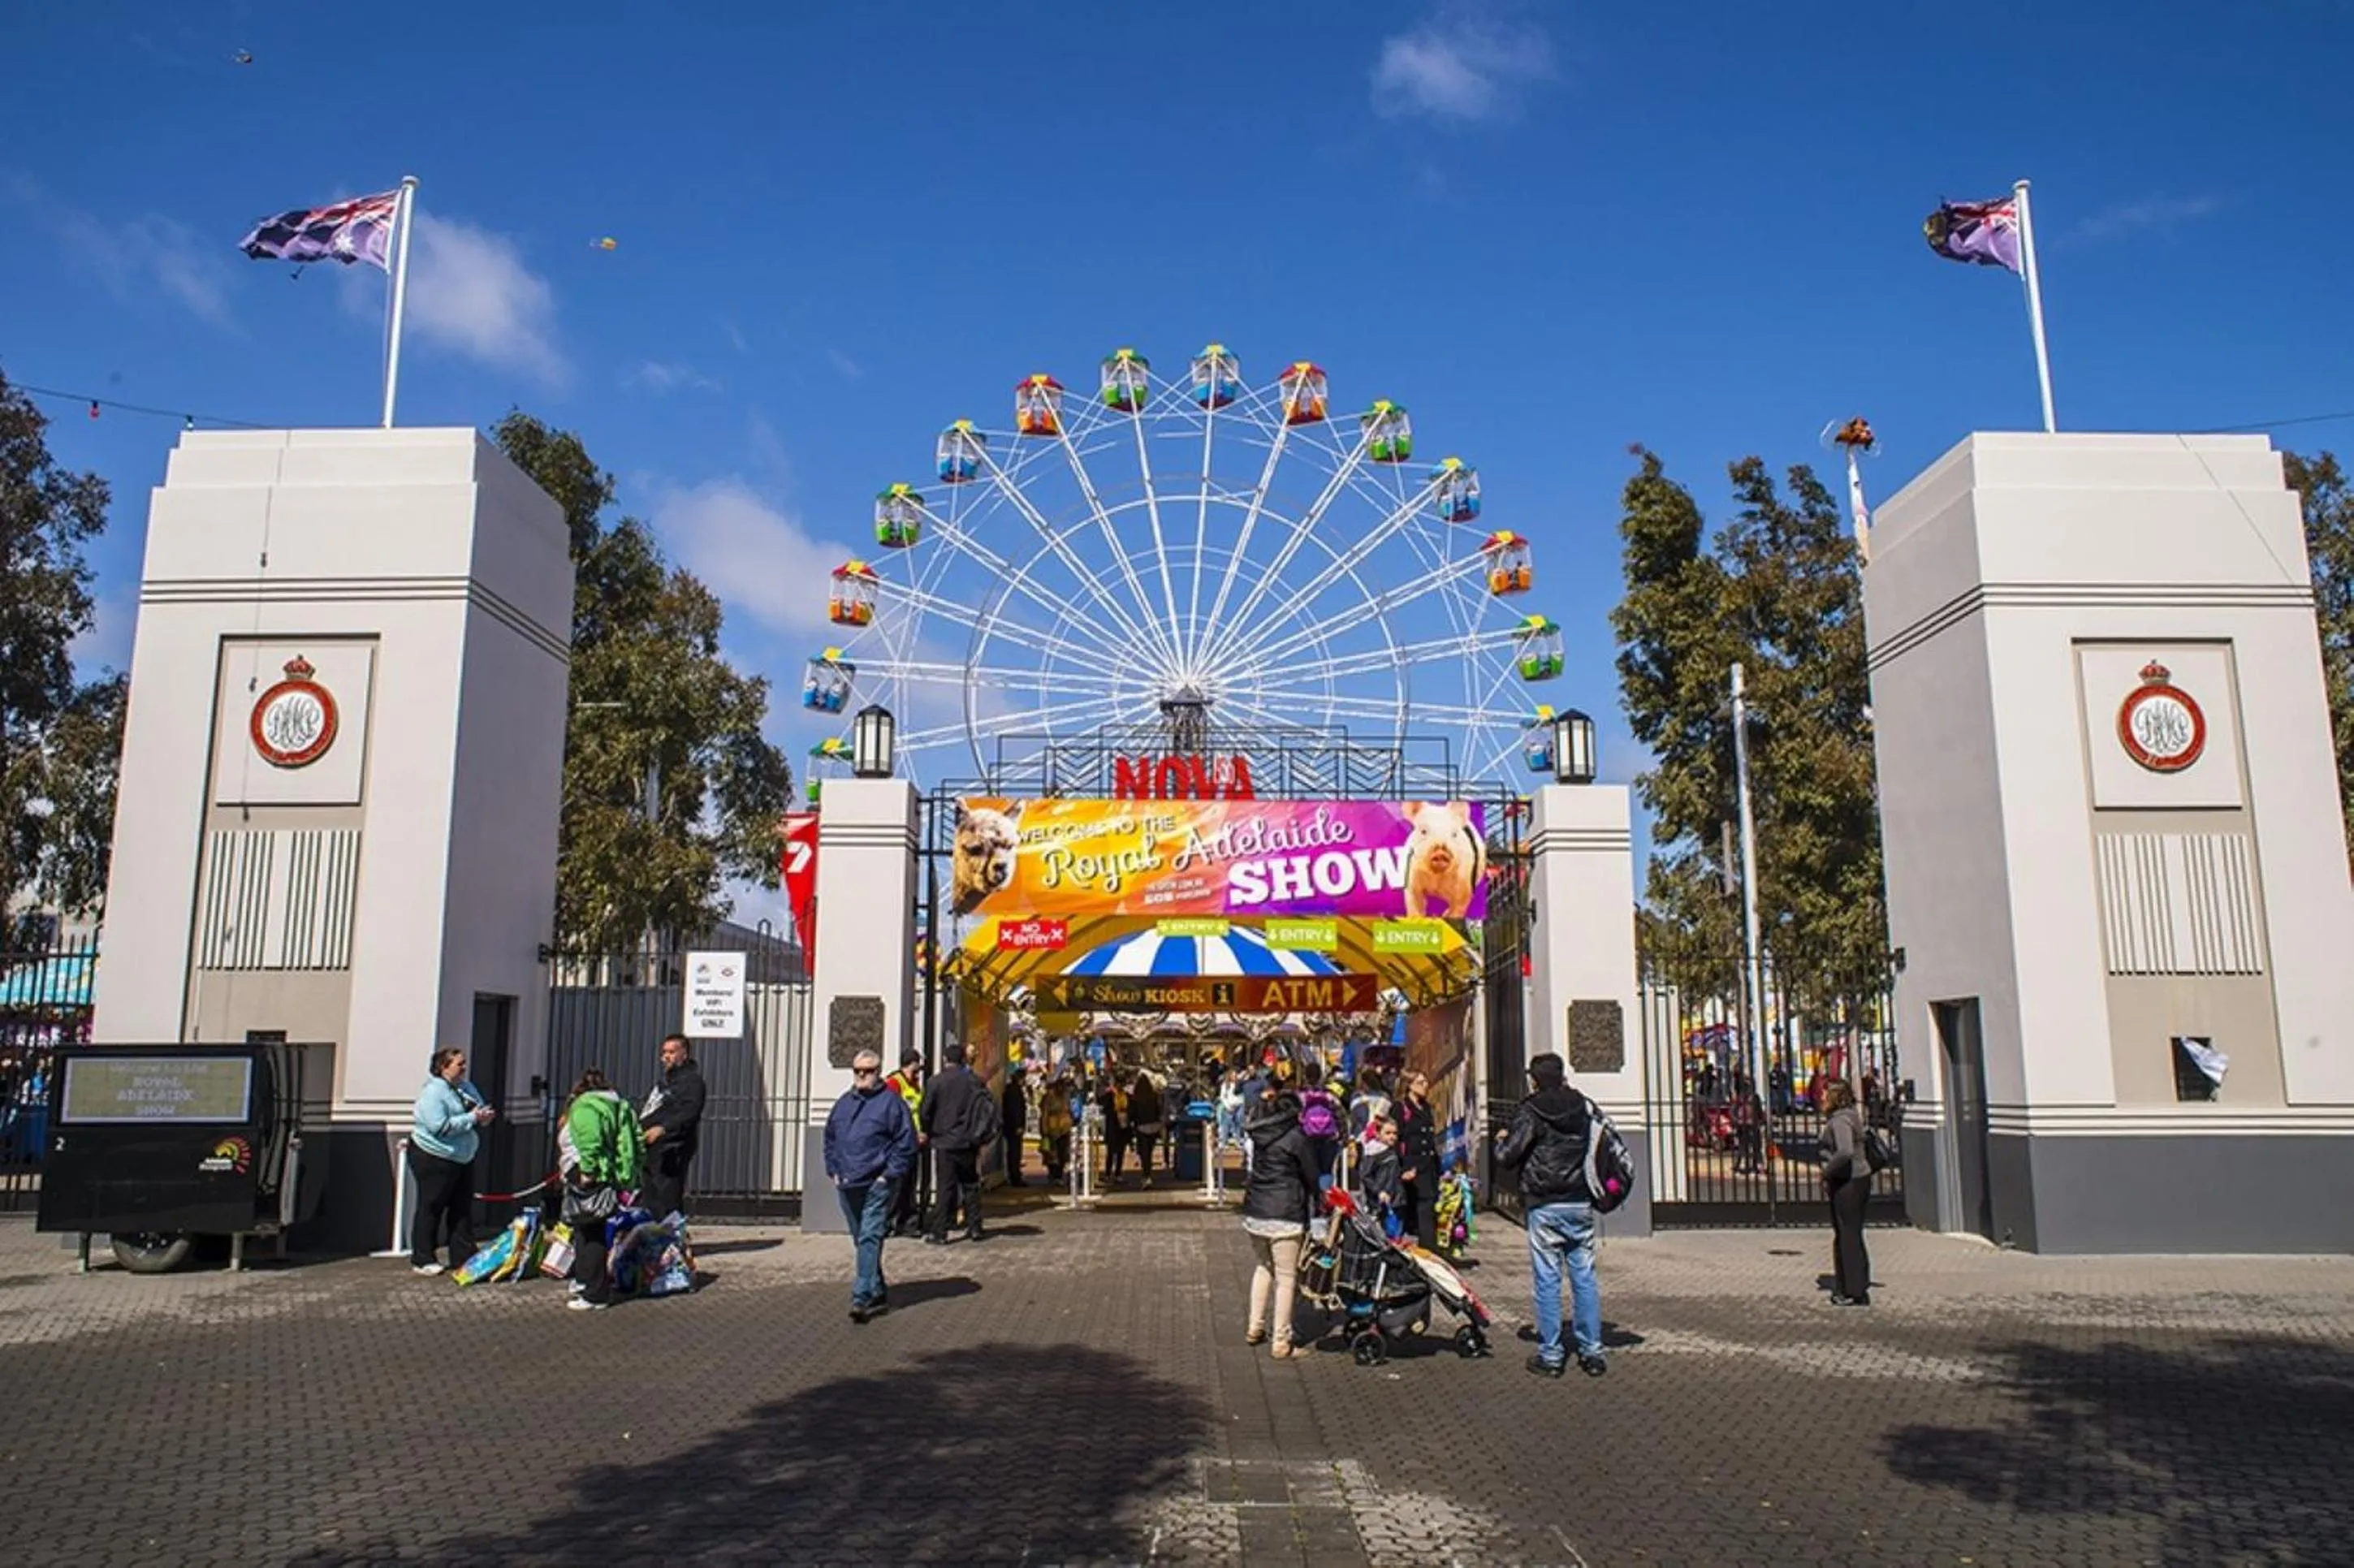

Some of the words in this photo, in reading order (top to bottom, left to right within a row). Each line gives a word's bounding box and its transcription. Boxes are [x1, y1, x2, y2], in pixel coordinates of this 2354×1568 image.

[1116, 754, 1255, 800] NOVA
[1017, 819, 1108, 844] WELCOME
[1112, 814, 1138, 836] TO
[1142, 814, 1177, 833] THE
[1040, 834, 1163, 893] Royal
[1173, 806, 1354, 871] Adelaide
[1228, 844, 1415, 907] SHOW
[1021, 923, 1040, 934] NO
[1170, 922, 1215, 931] ENTRY
[1013, 931, 1052, 946] ENTRY
[1280, 928, 1322, 943] ENTRY
[1386, 929, 1429, 944] ENTRY
[1144, 987, 1206, 1004] KIOSK
[1262, 979, 1333, 1009] ATM
[55, 1136, 65, 1151] 2
